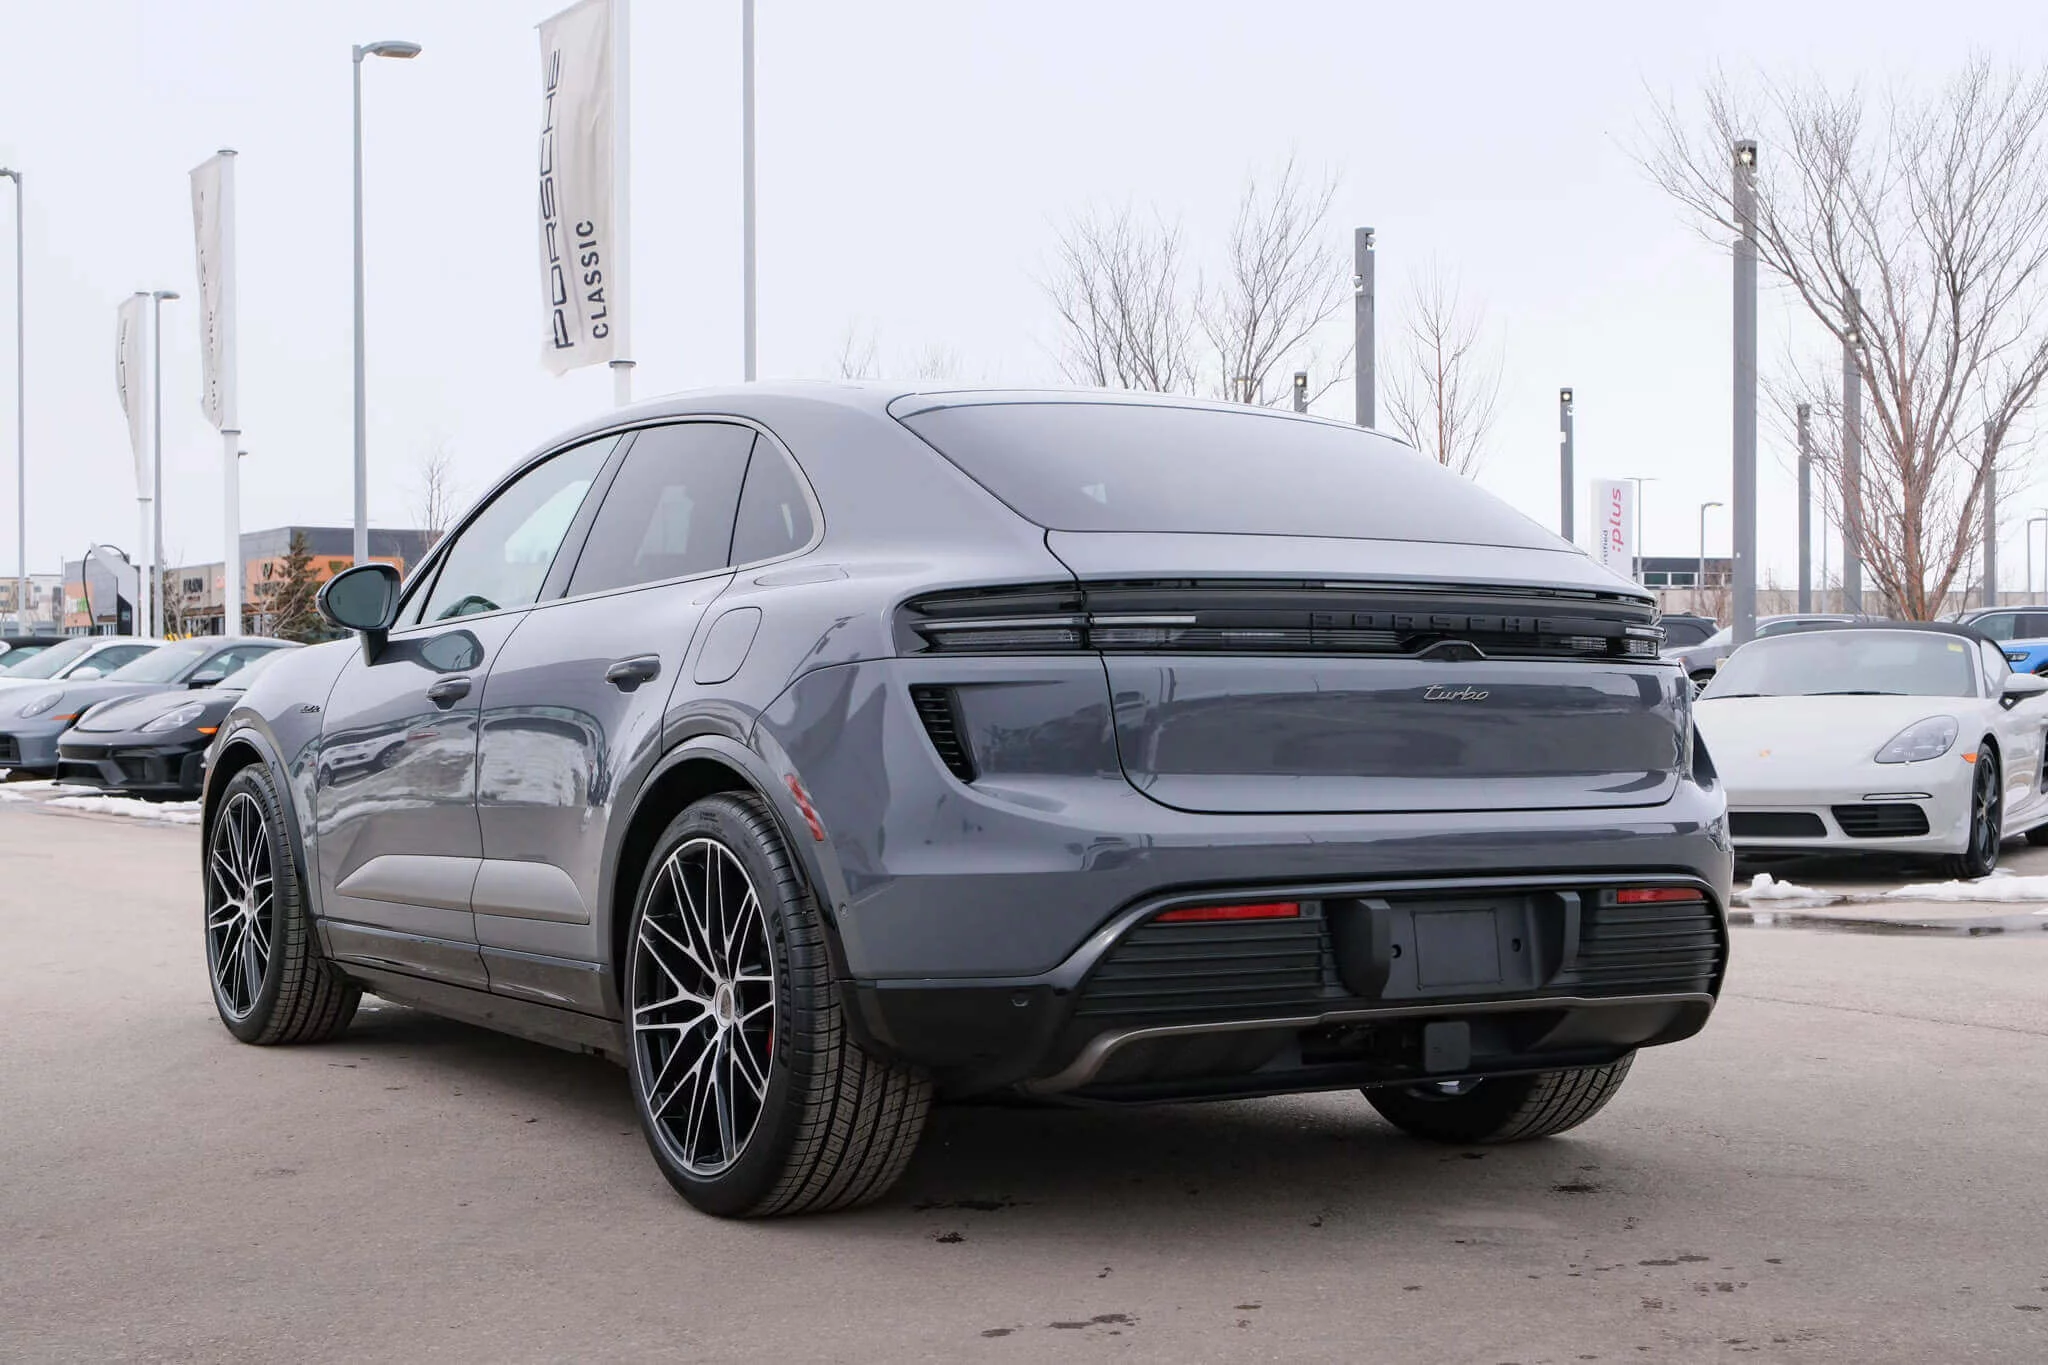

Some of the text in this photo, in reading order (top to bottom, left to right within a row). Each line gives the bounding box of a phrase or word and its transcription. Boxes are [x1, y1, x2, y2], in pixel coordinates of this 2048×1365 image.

[538, 48, 574, 349] PORSCHE
[575, 219, 609, 339] CLASSIC
[1311, 611, 1555, 633] PORSCHE
[1423, 684, 1489, 701] turbo
